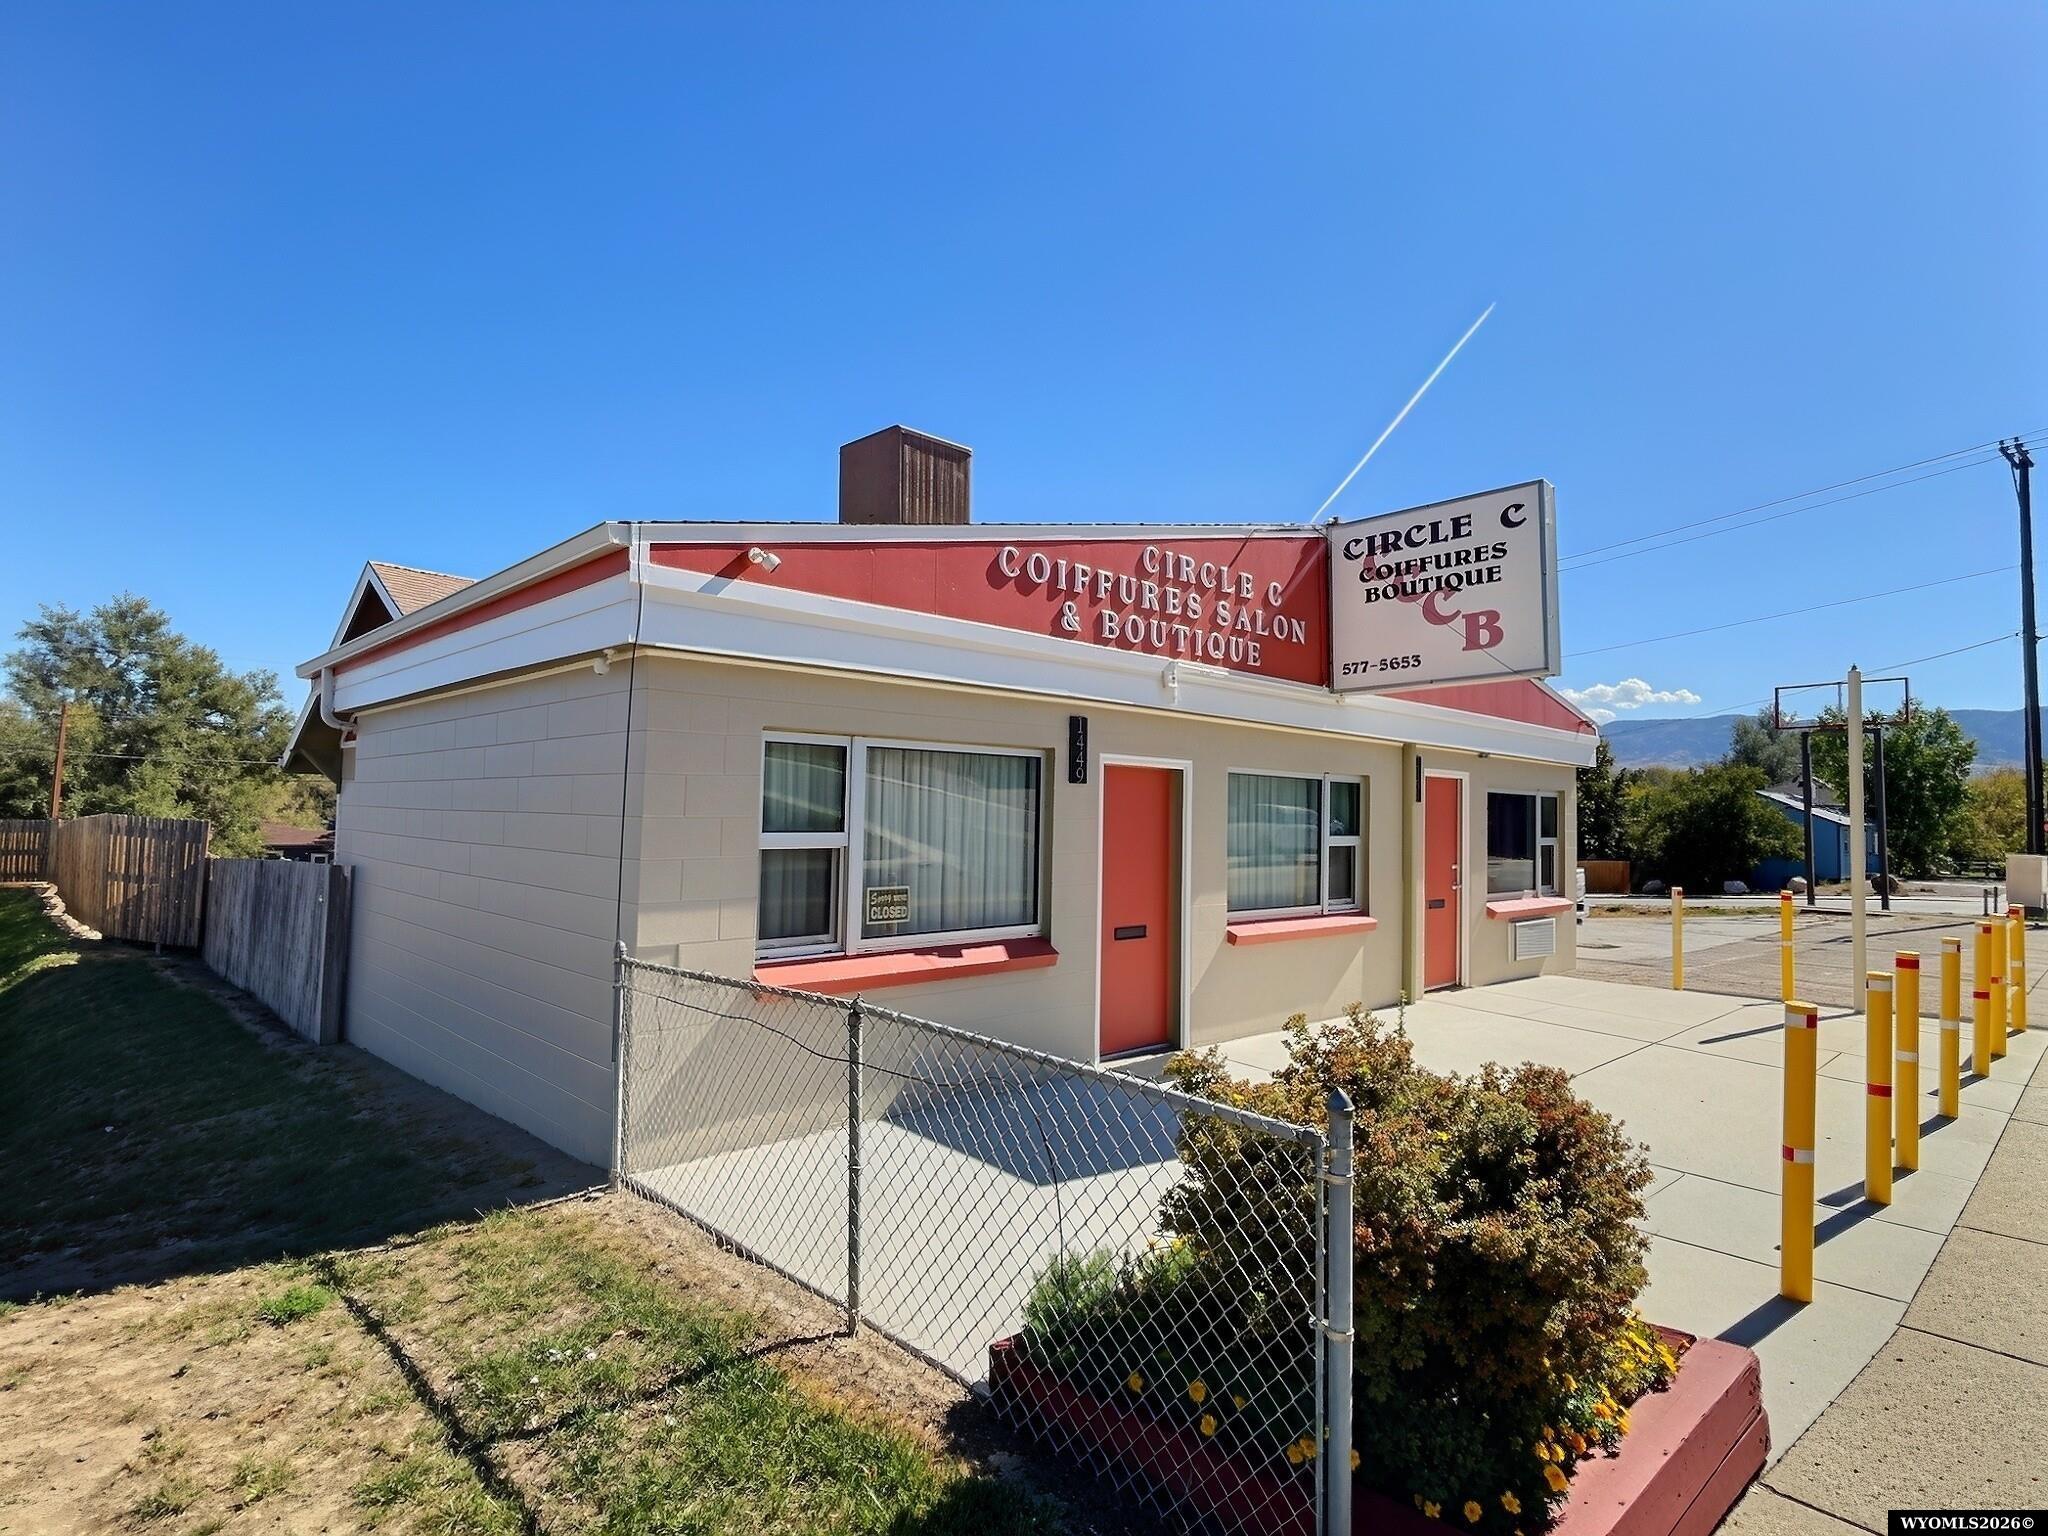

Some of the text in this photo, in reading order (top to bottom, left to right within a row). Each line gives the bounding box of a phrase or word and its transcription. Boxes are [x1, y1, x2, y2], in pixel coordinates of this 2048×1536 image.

[1343, 503, 1527, 560] CIRCLE C
[1142, 545, 1283, 607] CIRCLE C
[1359, 541, 1508, 583] COIFFURES
[1364, 565, 1502, 604] BOUTIQUE
[998, 545, 1306, 645] COIFFURES SALON
[1422, 584, 1461, 626] C
[1461, 609, 1504, 651] B
[1060, 600, 1262, 667] & BOUTIQUE
[1342, 654, 1422, 676] 577-5653
[1076, 716, 1085, 784] 1449
[871, 905, 908, 920] CLOSED
